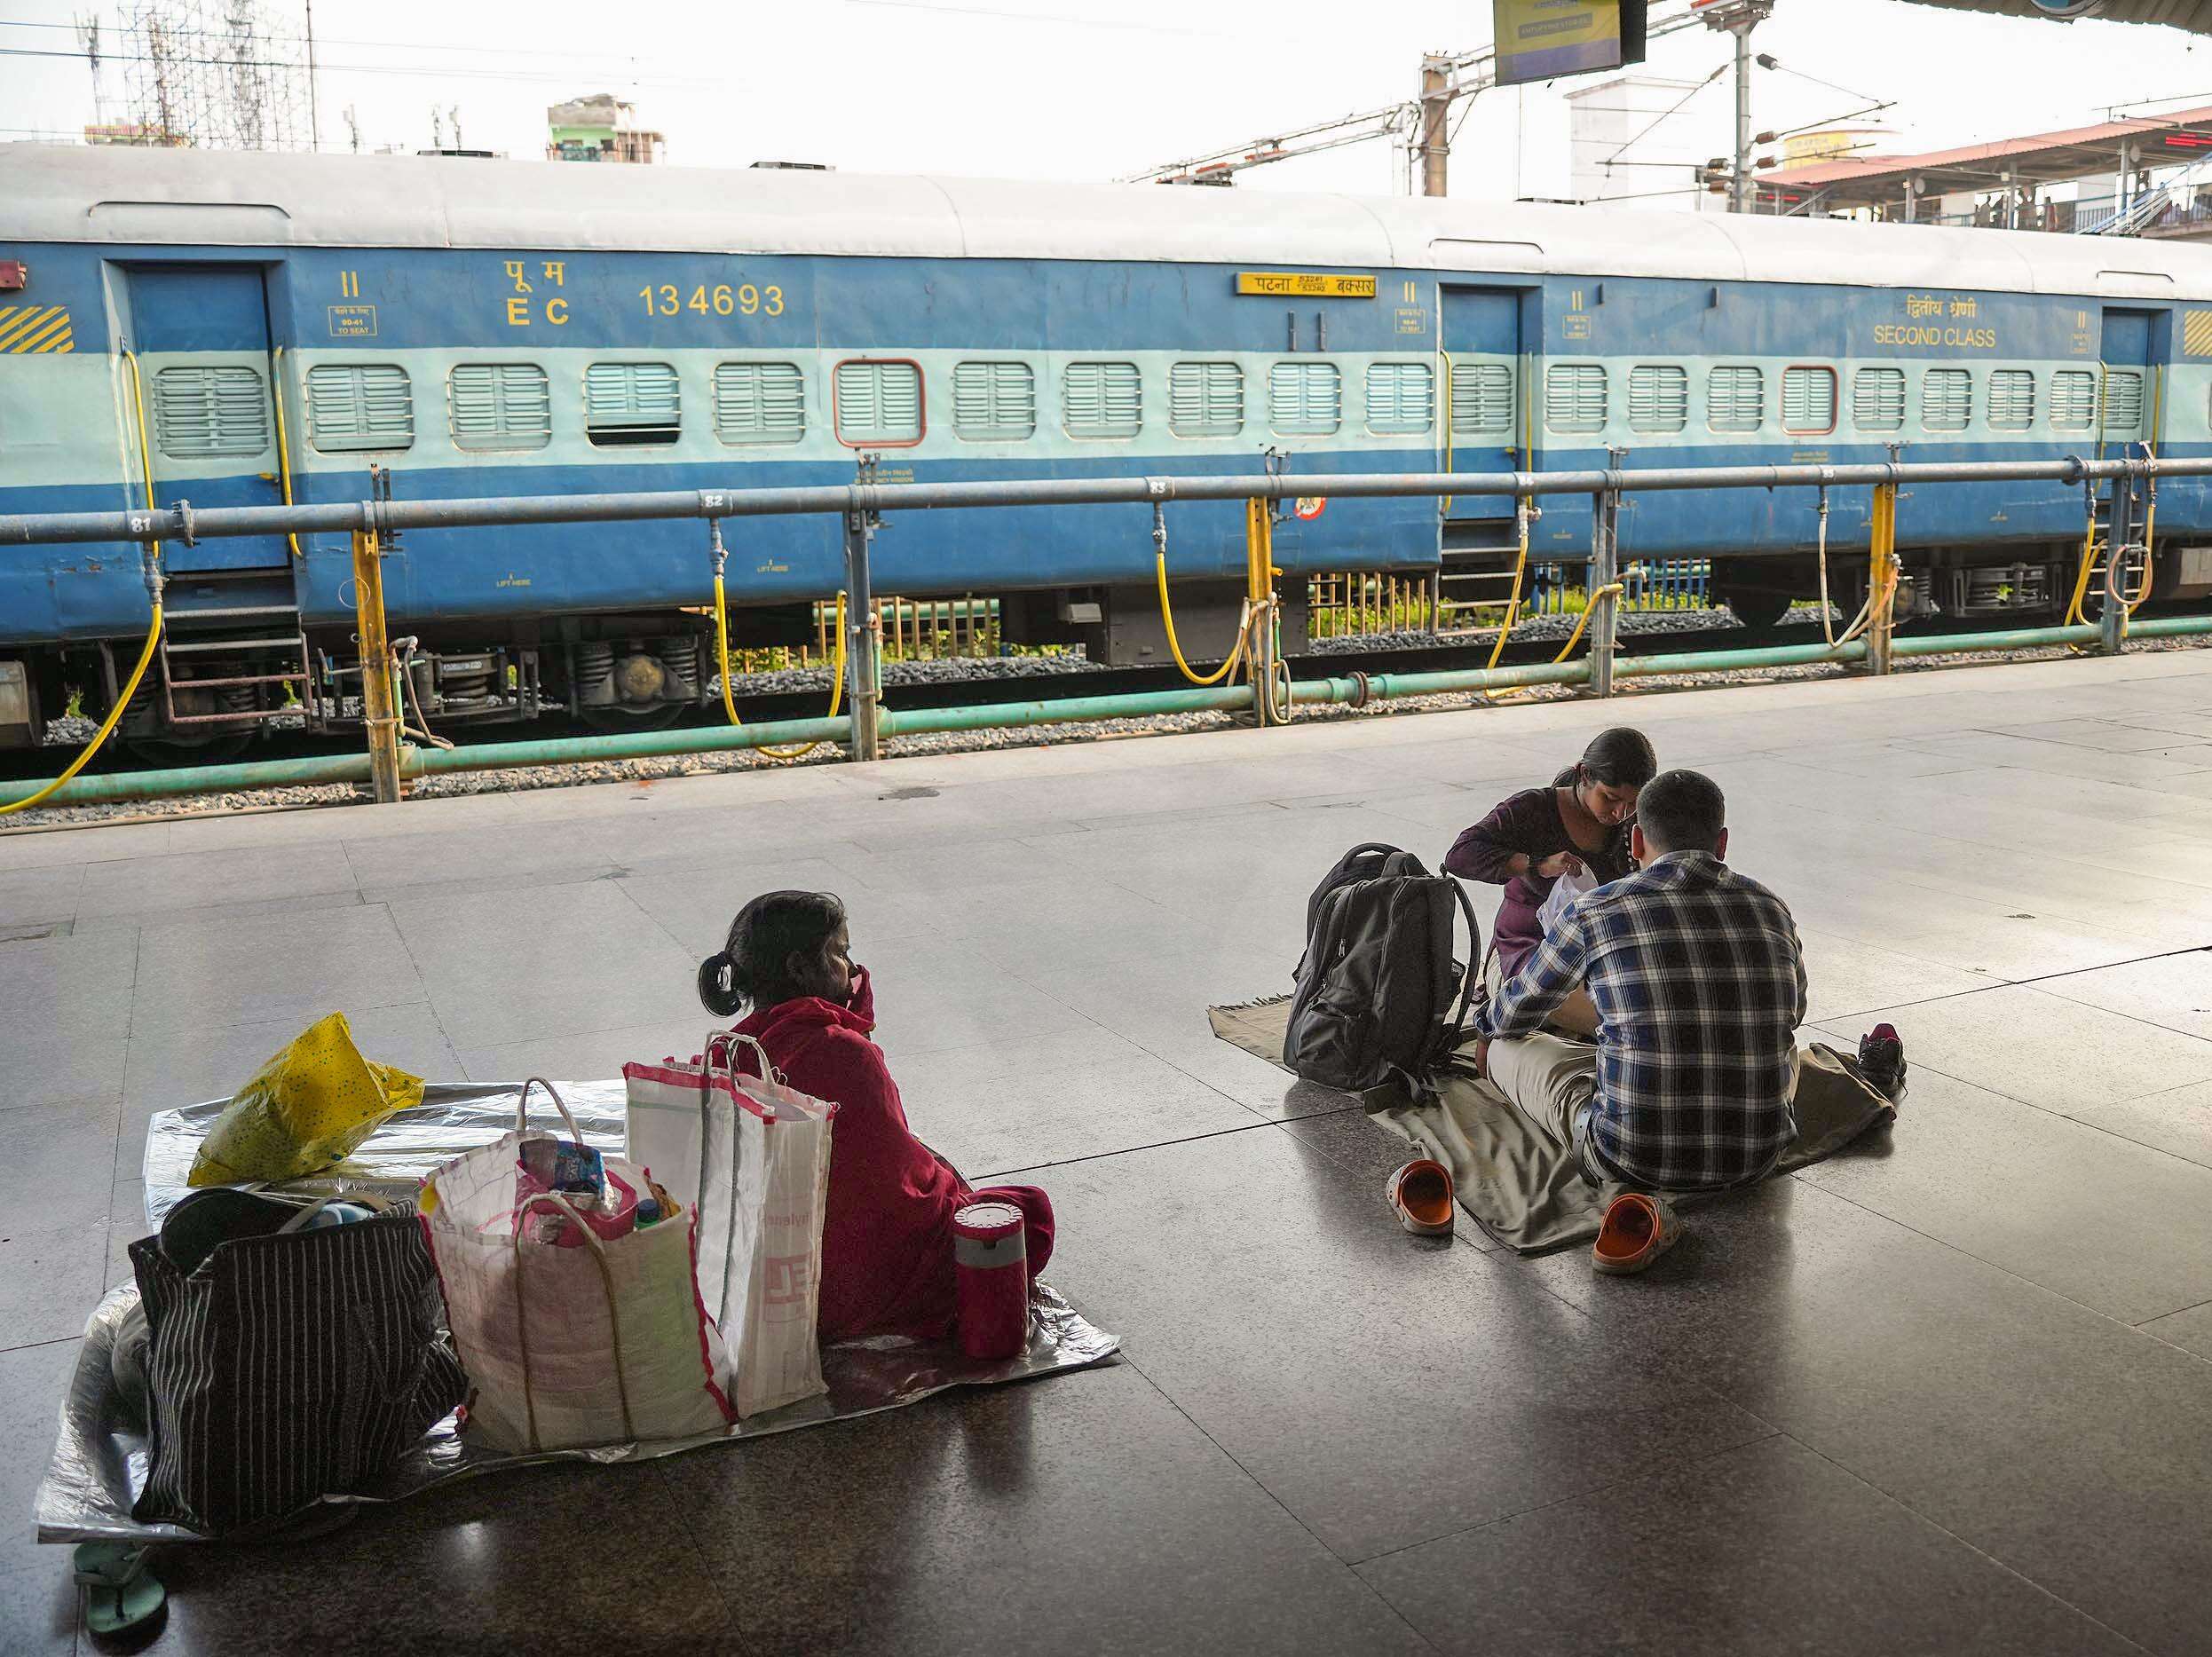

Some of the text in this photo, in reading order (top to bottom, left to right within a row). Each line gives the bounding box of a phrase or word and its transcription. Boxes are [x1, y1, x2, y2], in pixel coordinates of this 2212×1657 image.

[541, 262, 565, 286] म
[1254, 277, 1292, 292] पटना
[639, 284, 785, 316] 134693
[1905, 294, 1977, 319] द्वितीय श्रेणी
[1874, 325, 1996, 347] SECOND CLASS
[705, 495, 723, 507] 82
[131, 517, 151, 533] 81
